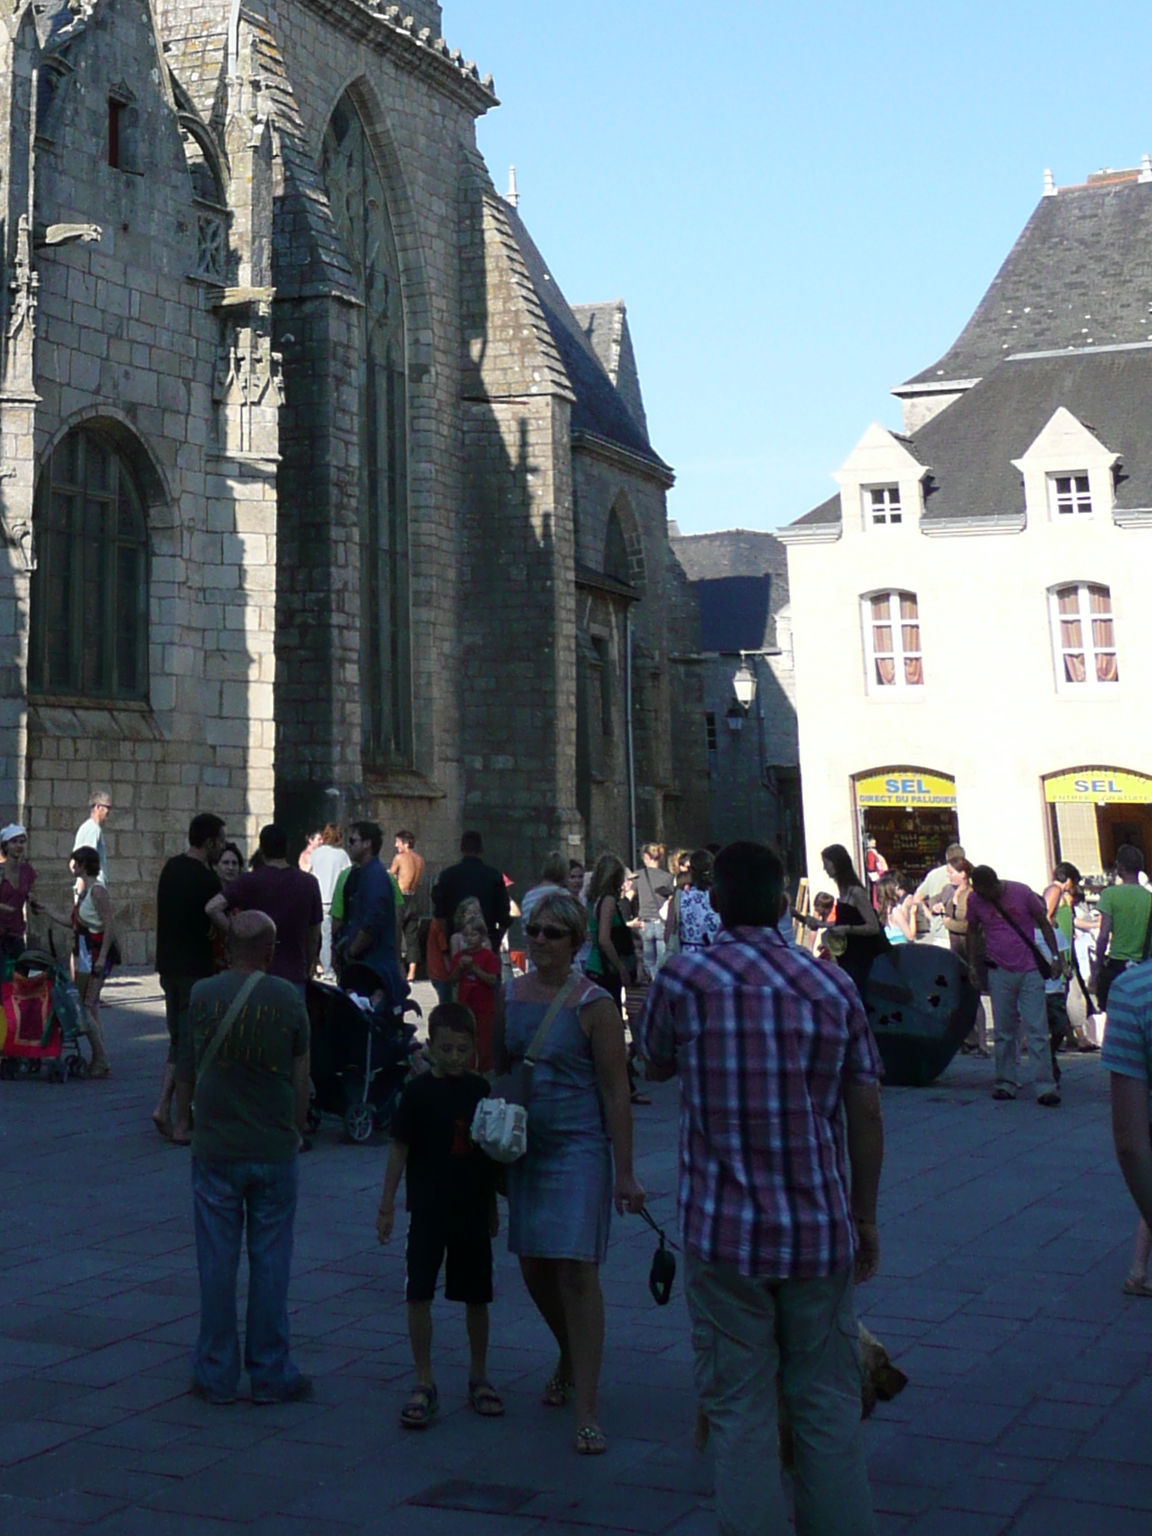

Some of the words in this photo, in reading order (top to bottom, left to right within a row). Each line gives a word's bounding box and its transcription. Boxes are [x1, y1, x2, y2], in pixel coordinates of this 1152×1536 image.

[885, 779, 931, 794] SEL
[1074, 780, 1123, 793] SEL
[859, 795, 893, 803] DIRECT
[895, 795, 909, 803] DU
[911, 795, 957, 804] PALUDIER
